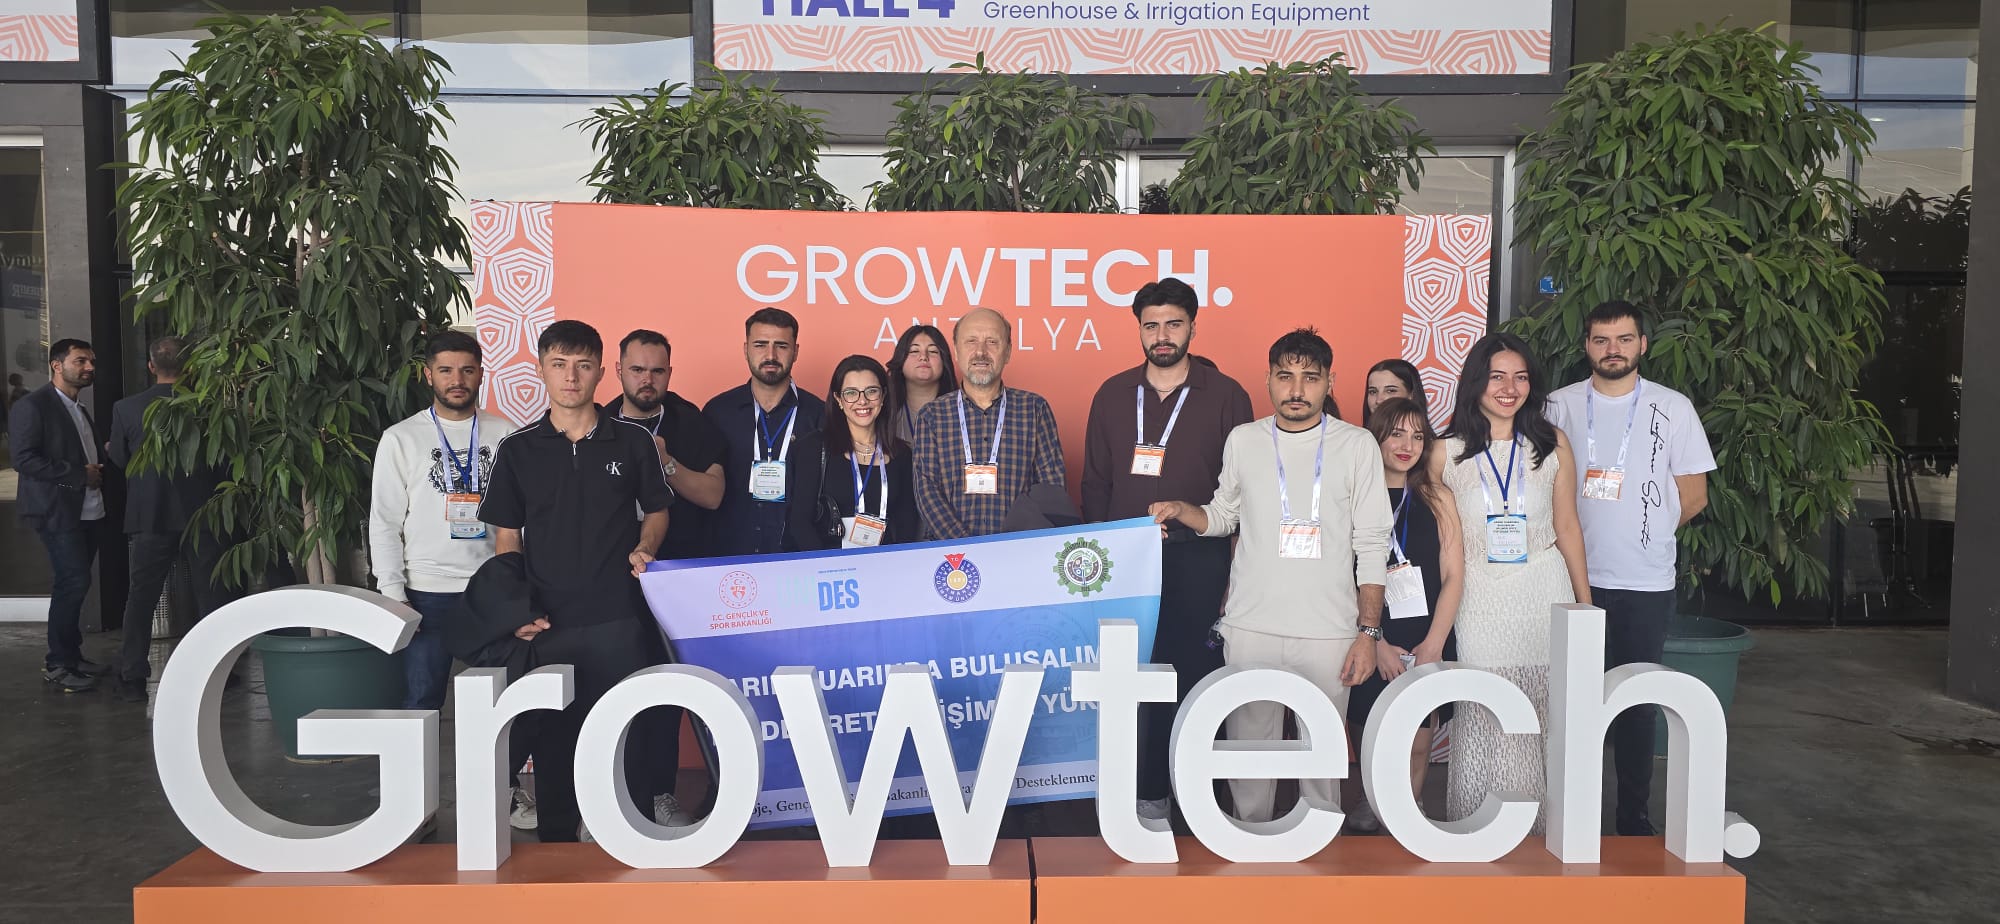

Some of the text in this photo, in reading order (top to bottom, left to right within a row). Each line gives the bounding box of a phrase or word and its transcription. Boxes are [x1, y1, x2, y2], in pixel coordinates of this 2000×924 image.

[984, 1, 1371, 27] Greenhouse & Irrigation Equipment
[873, 316, 1102, 351] ALYA
[817, 578, 860, 611] DES
[710, 617, 772, 630] SPOR BAKANLIĞI
[759, 609, 769, 617] VE
[152, 584, 1761, 874] Growtech.
